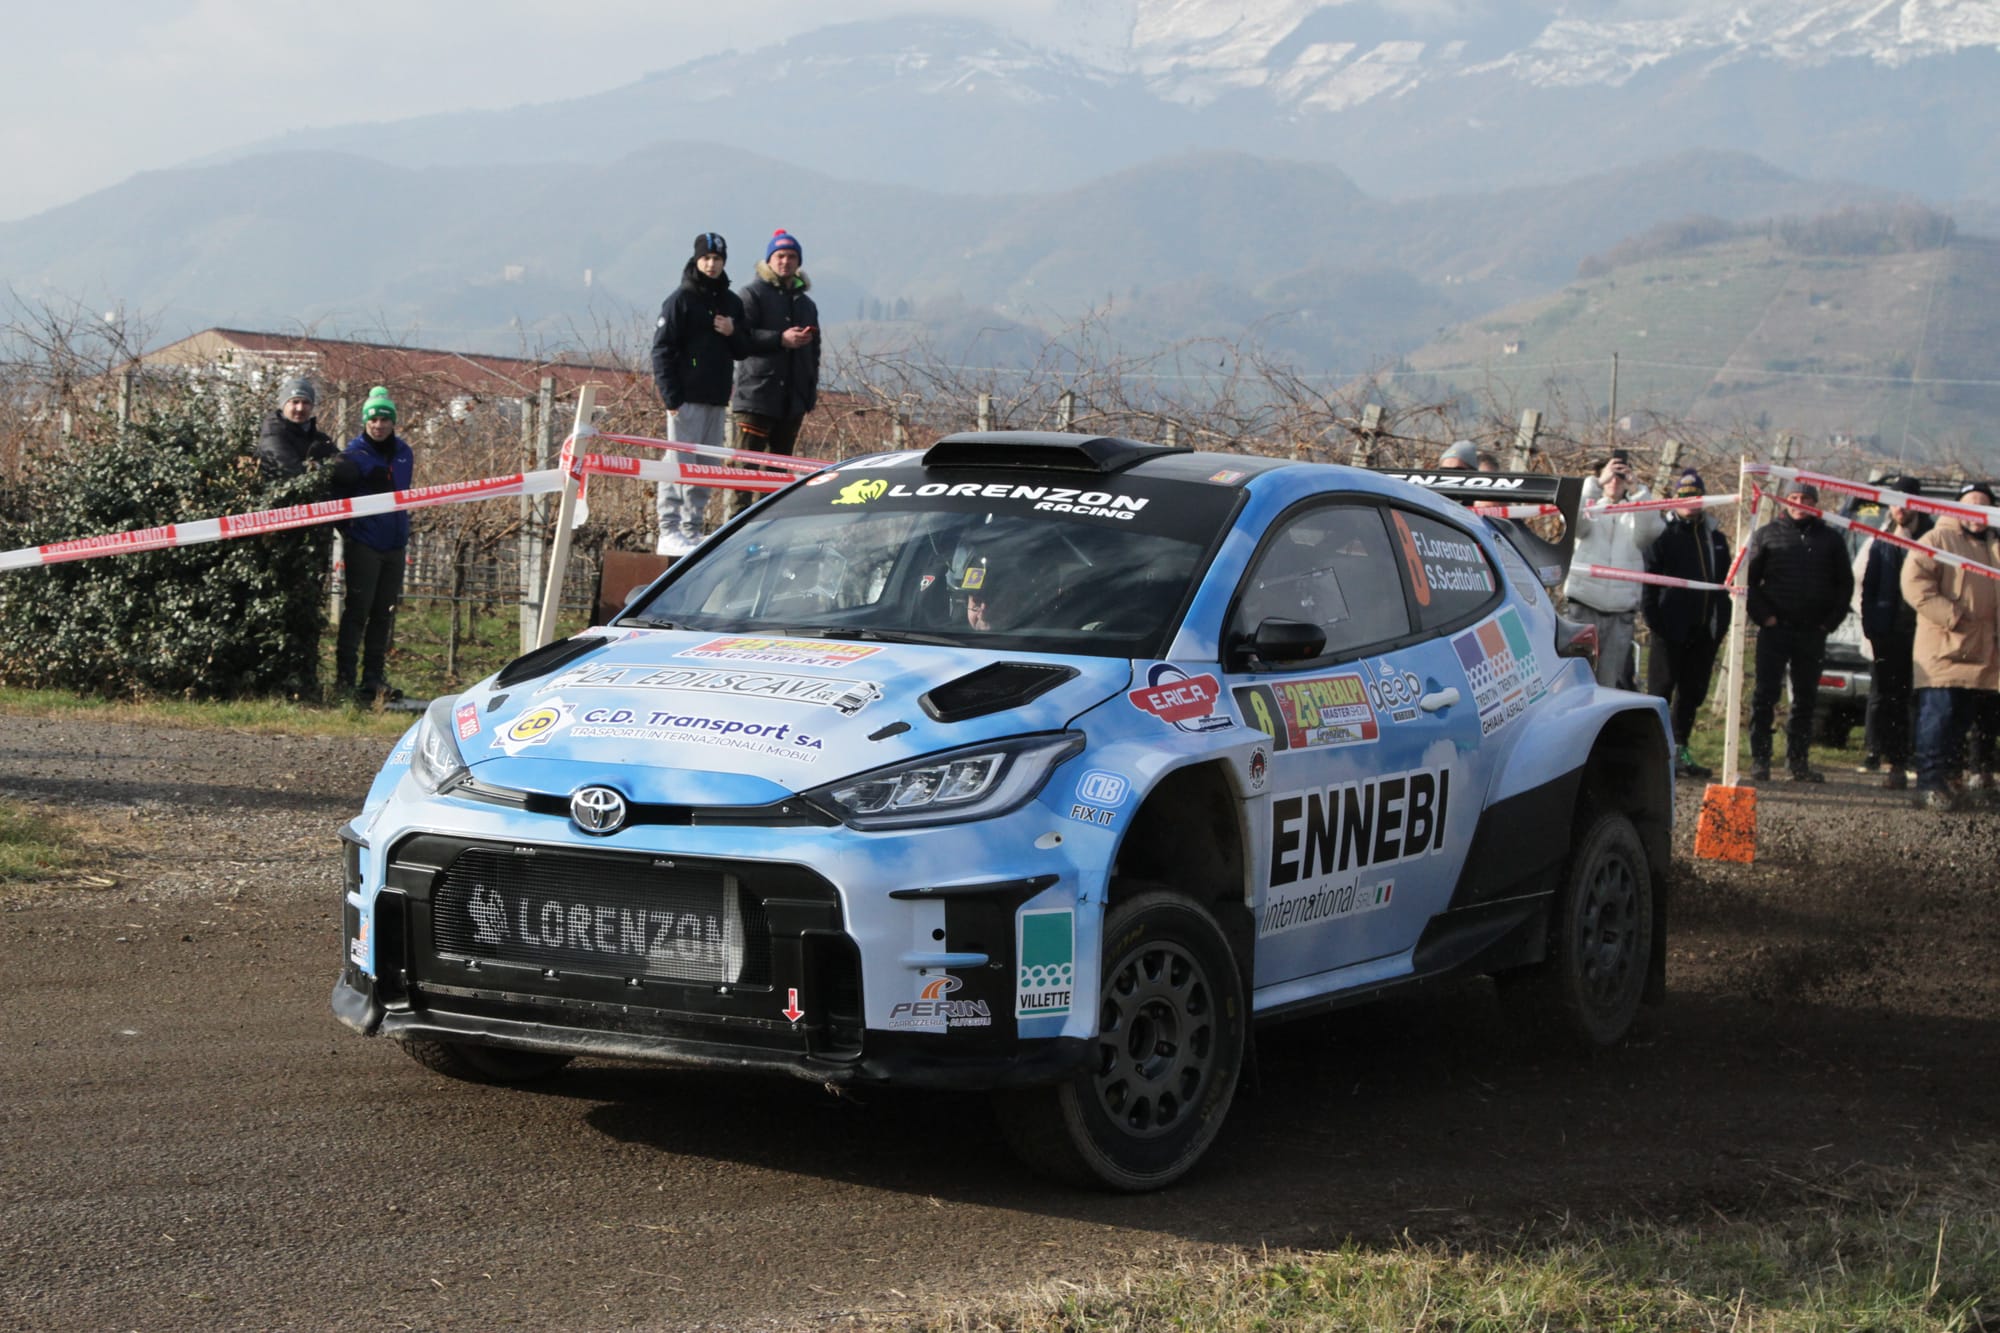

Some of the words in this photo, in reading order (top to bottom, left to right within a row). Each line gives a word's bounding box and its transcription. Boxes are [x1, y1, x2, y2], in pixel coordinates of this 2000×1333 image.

[311, 500, 345, 516] ZONA
[887, 483, 1150, 510] LORENZON
[226, 505, 309, 530] PERICOLOSA
[1033, 501, 1136, 521] RACING
[1411, 531, 1476, 562] F.Lorenzon
[1425, 564, 1485, 591] S.Scattolin
[679, 651, 843, 667] CONCORRENTE
[576, 668, 625, 683] LA
[636, 670, 832, 698] EDILSCAVI
[1361, 659, 1422, 717] deep
[1148, 684, 1209, 711] E.RIC.A.
[1286, 684, 1319, 728] 25
[1311, 678, 1366, 707] PREALPI
[517, 717, 551, 731] CD
[1250, 691, 1275, 738] 8
[1481, 712, 1505, 734] GHIAIA
[584, 710, 633, 724] C.D.
[648, 712, 790, 740] Transport
[794, 735, 823, 749] SA
[572, 727, 645, 738] TRASPORTI
[646, 729, 764, 751] INTERNAZIONALI
[765, 745, 817, 763] MOBILI
[1070, 805, 1096, 822] FIX
[1098, 810, 1115, 825] IT
[1269, 769, 1449, 888] ENNEBI
[1262, 876, 1359, 933] international
[519, 897, 732, 963] LORENZON
[889, 1000, 991, 1018] PERIN
[1020, 991, 1070, 1009] VILLETTE
